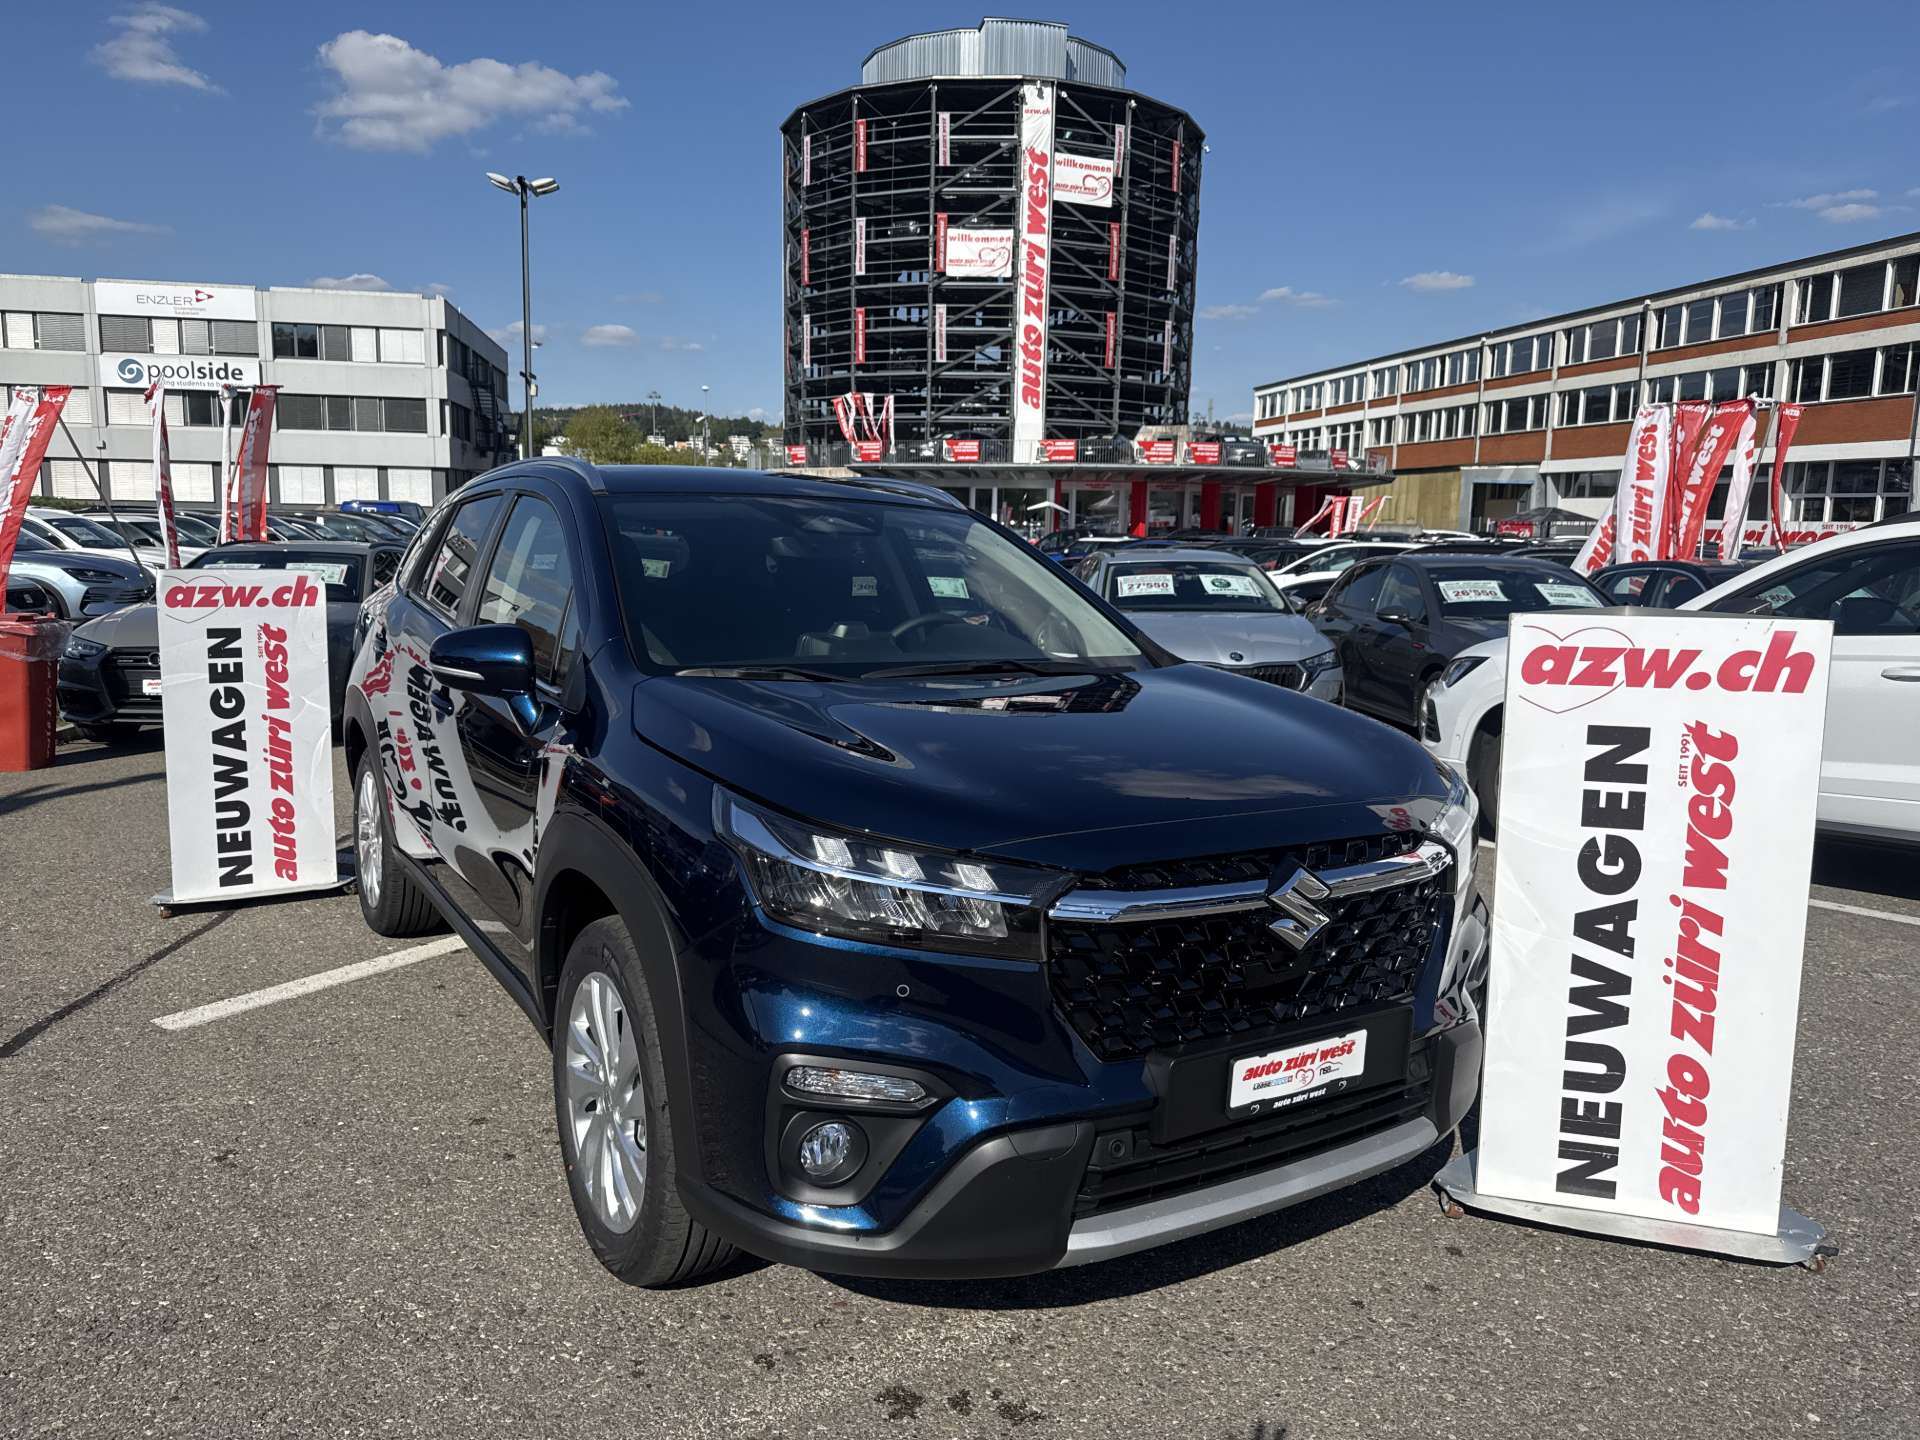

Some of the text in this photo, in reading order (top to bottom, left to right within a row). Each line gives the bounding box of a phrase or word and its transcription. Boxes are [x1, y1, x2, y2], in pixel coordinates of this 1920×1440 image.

[1055, 158, 1112, 173] willkommen
[949, 233, 1011, 243] willkommen
[136, 294, 193, 306] ENZLER
[1020, 145, 1049, 410] auto züri west
[147, 360, 243, 385] poolside
[1635, 424, 1657, 481] west
[1629, 484, 1653, 543] züri
[165, 576, 320, 608] azw.ch
[1520, 630, 1816, 694] azw.ch
[206, 627, 253, 888] NEUWAGEN
[262, 621, 297, 882] auto züri west
[1678, 733, 1692, 789] SEIT 1991
[1555, 723, 1652, 1200] NEUWAGEN
[1654, 720, 1739, 1216] auto züri west
[1242, 1039, 1356, 1081] auto züri west
[1273, 1087, 1327, 1109] auto züri west
